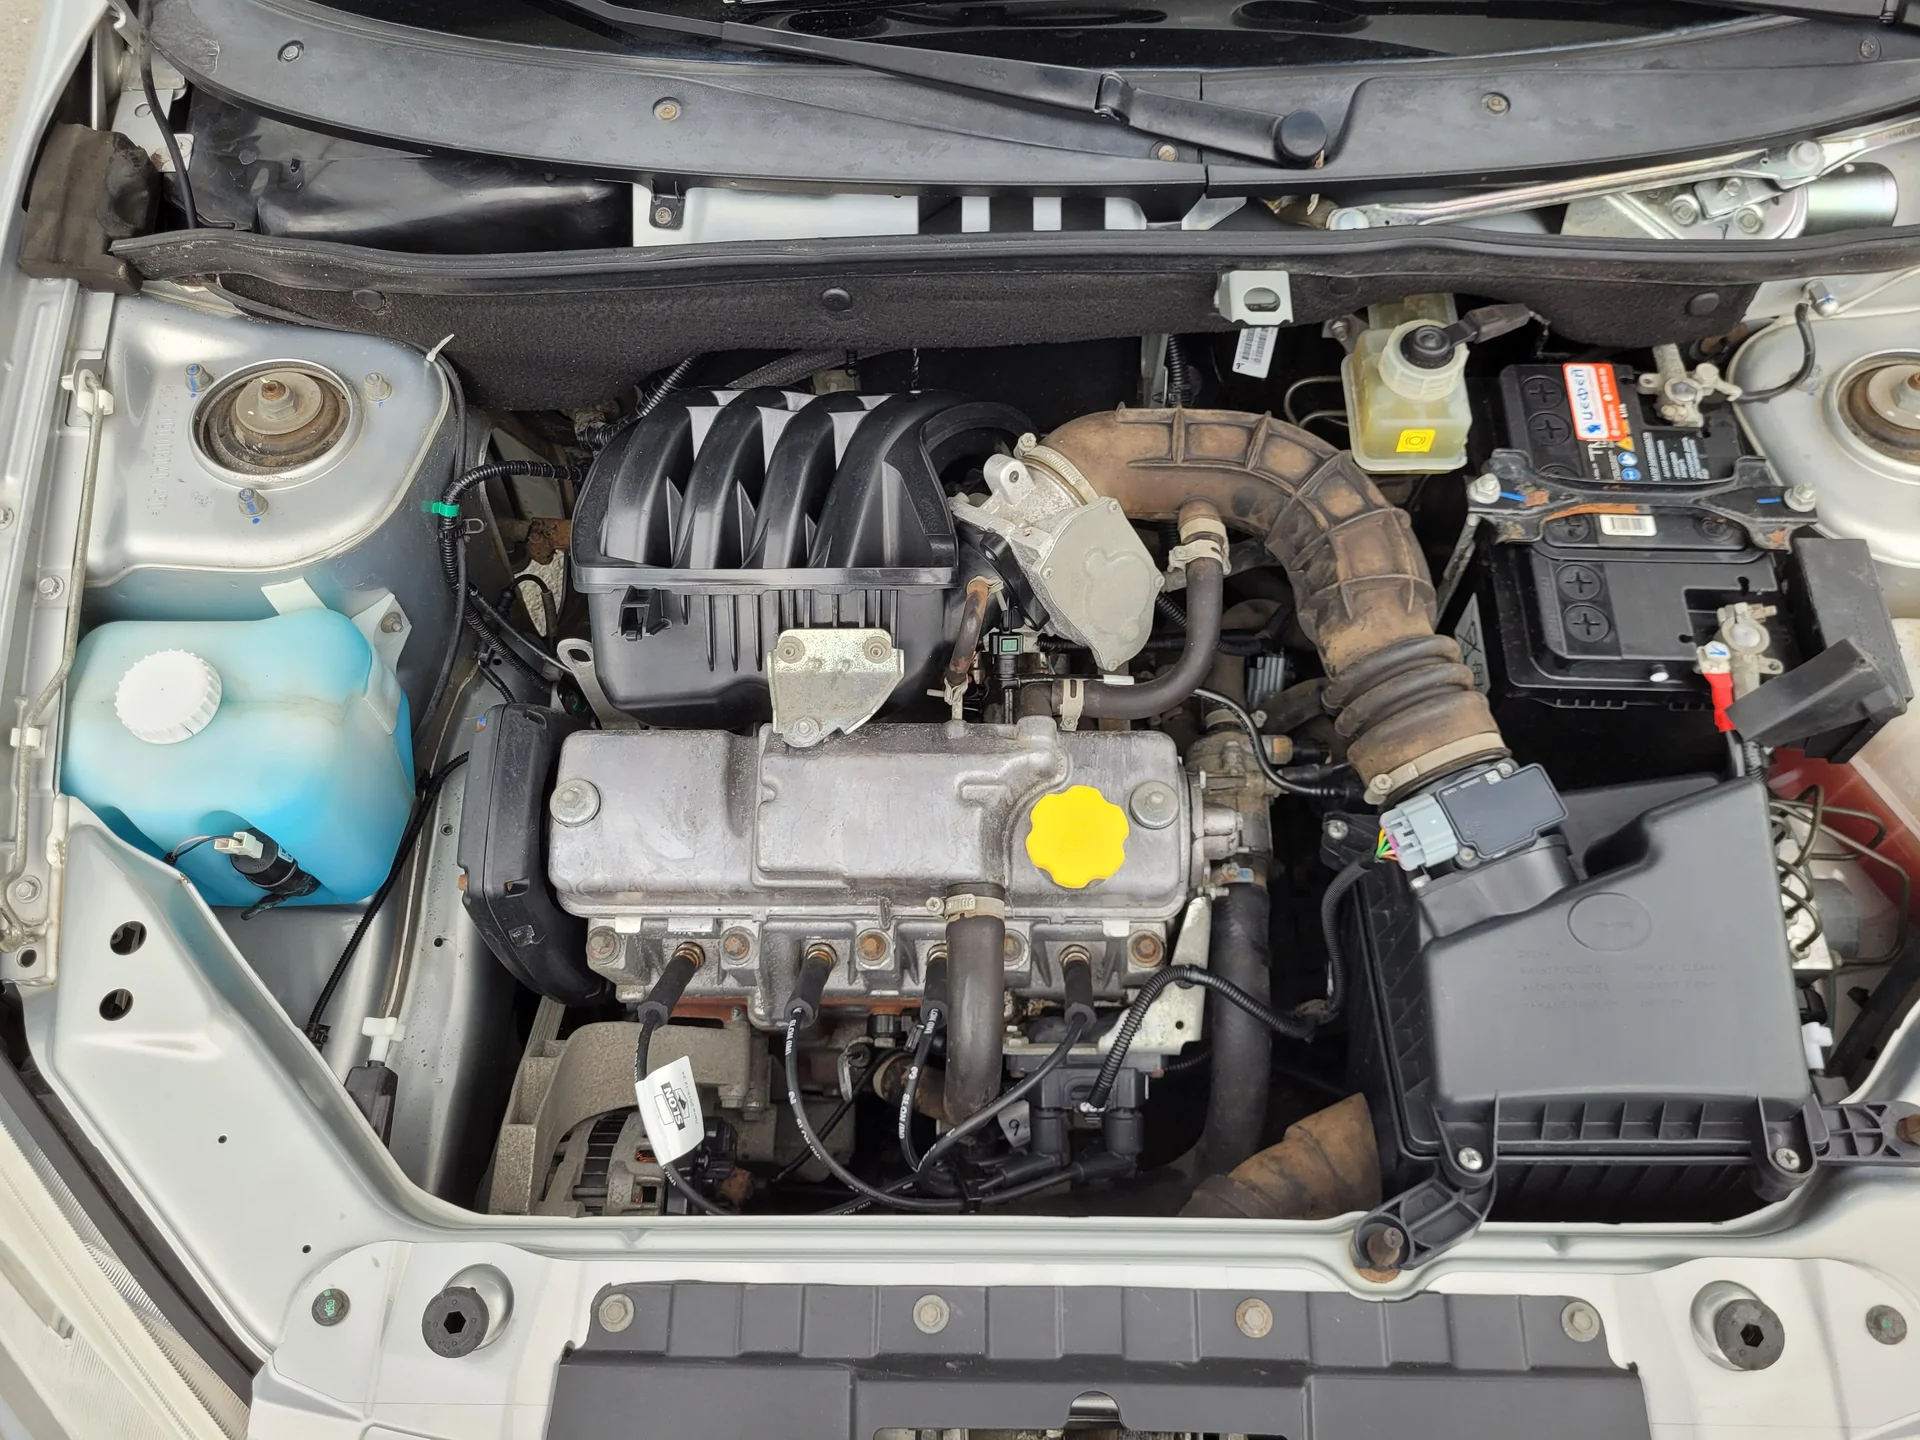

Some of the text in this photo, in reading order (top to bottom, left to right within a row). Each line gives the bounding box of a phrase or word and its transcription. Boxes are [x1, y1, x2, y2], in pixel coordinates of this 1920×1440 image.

[908, 1066, 919, 1080] 3
[663, 1087, 684, 1126] SLON
[788, 1090, 797, 1105] 2
[899, 1093, 911, 1122] SLON
[1008, 1118, 1020, 1137] 9
